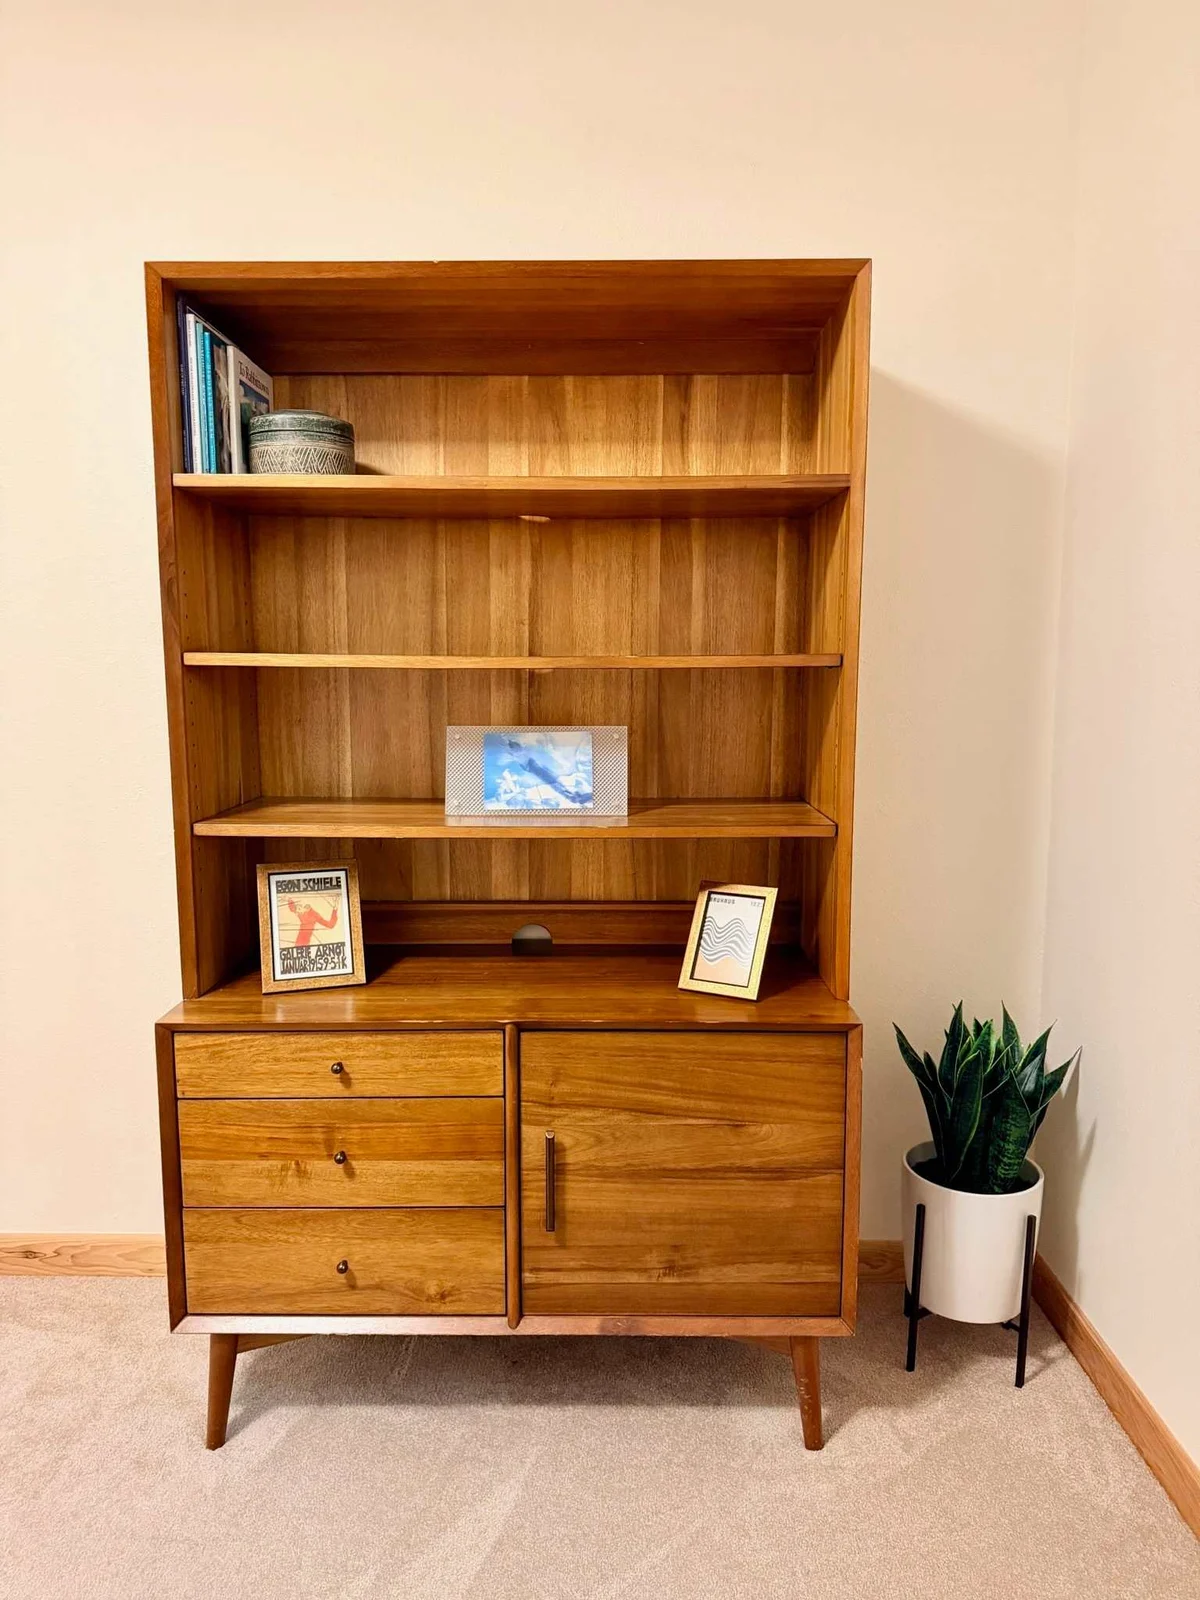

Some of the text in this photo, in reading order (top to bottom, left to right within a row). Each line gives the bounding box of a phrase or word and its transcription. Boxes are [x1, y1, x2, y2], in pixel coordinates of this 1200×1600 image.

[276, 876, 342, 893] EGON SCHIELE
[280, 943, 346, 959] GALERIE ARNOT
